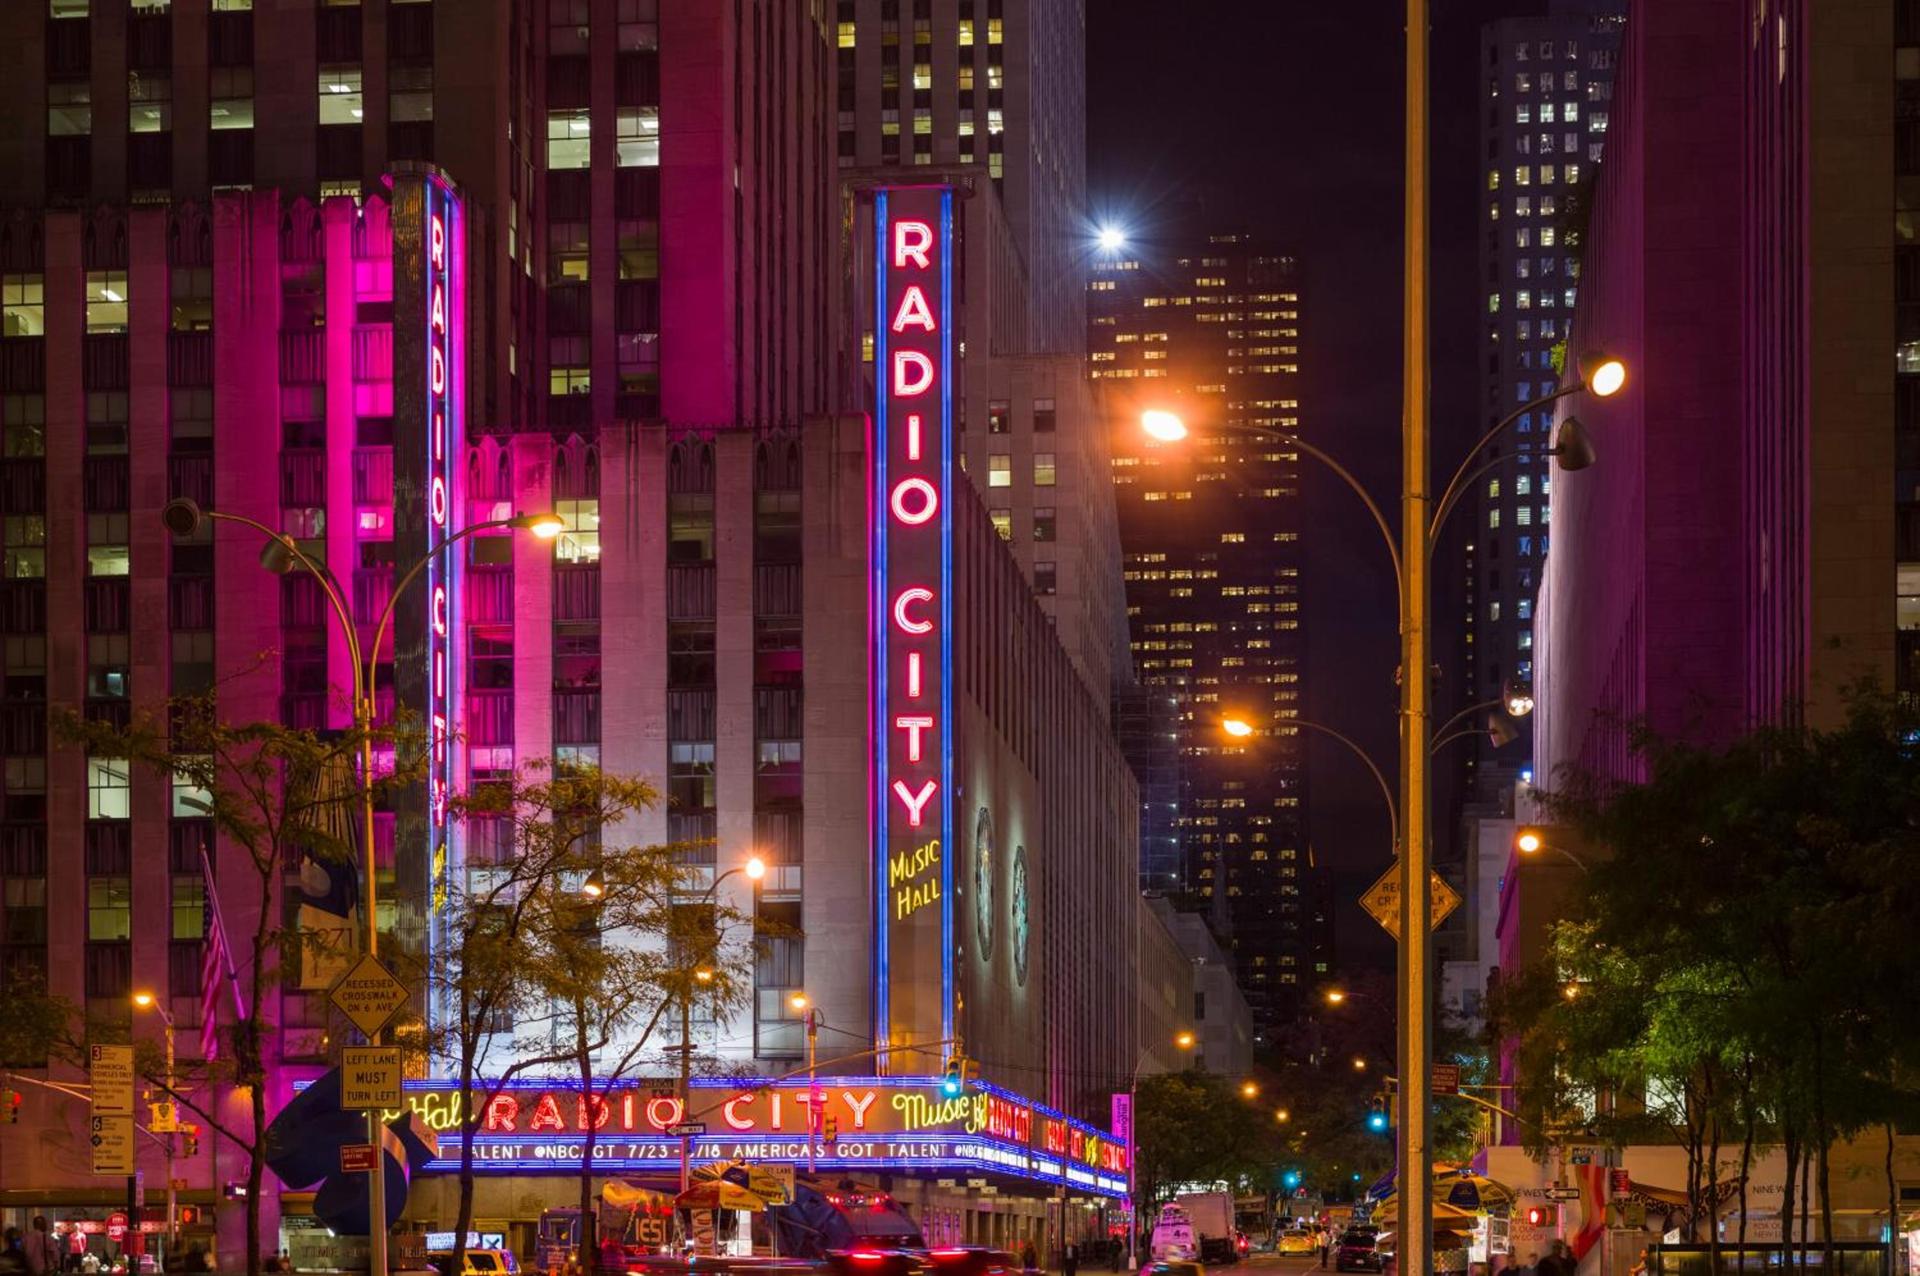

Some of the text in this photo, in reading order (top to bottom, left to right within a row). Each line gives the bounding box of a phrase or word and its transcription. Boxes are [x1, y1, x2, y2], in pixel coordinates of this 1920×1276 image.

[431, 215, 447, 525] RADIO
[891, 221, 938, 827] RADIO CITY
[890, 841, 940, 888] MUSIC
[898, 878, 940, 921] HALL
[346, 979, 394, 989] RECESSED
[342, 991, 398, 1001] CROSSWALK
[348, 1003, 359, 1012] ON
[376, 1003, 393, 1012] AVE
[93, 1046, 101, 1060] 3
[346, 1055, 397, 1065] LEFT LANE
[355, 1072, 388, 1084] MUST
[347, 1091, 397, 1101] TURN LEFT
[409, 1091, 474, 1131] Hal
[488, 1091, 876, 1131] RADIO CITY
[892, 1093, 969, 1132] Music
[93, 1116, 101, 1130] 6
[457, 1145, 523, 1160] ALENT
[837, 1143, 875, 1158] GOT
[888, 1143, 948, 1158] TALENT
[1753, 1185, 1774, 1194] NINE
